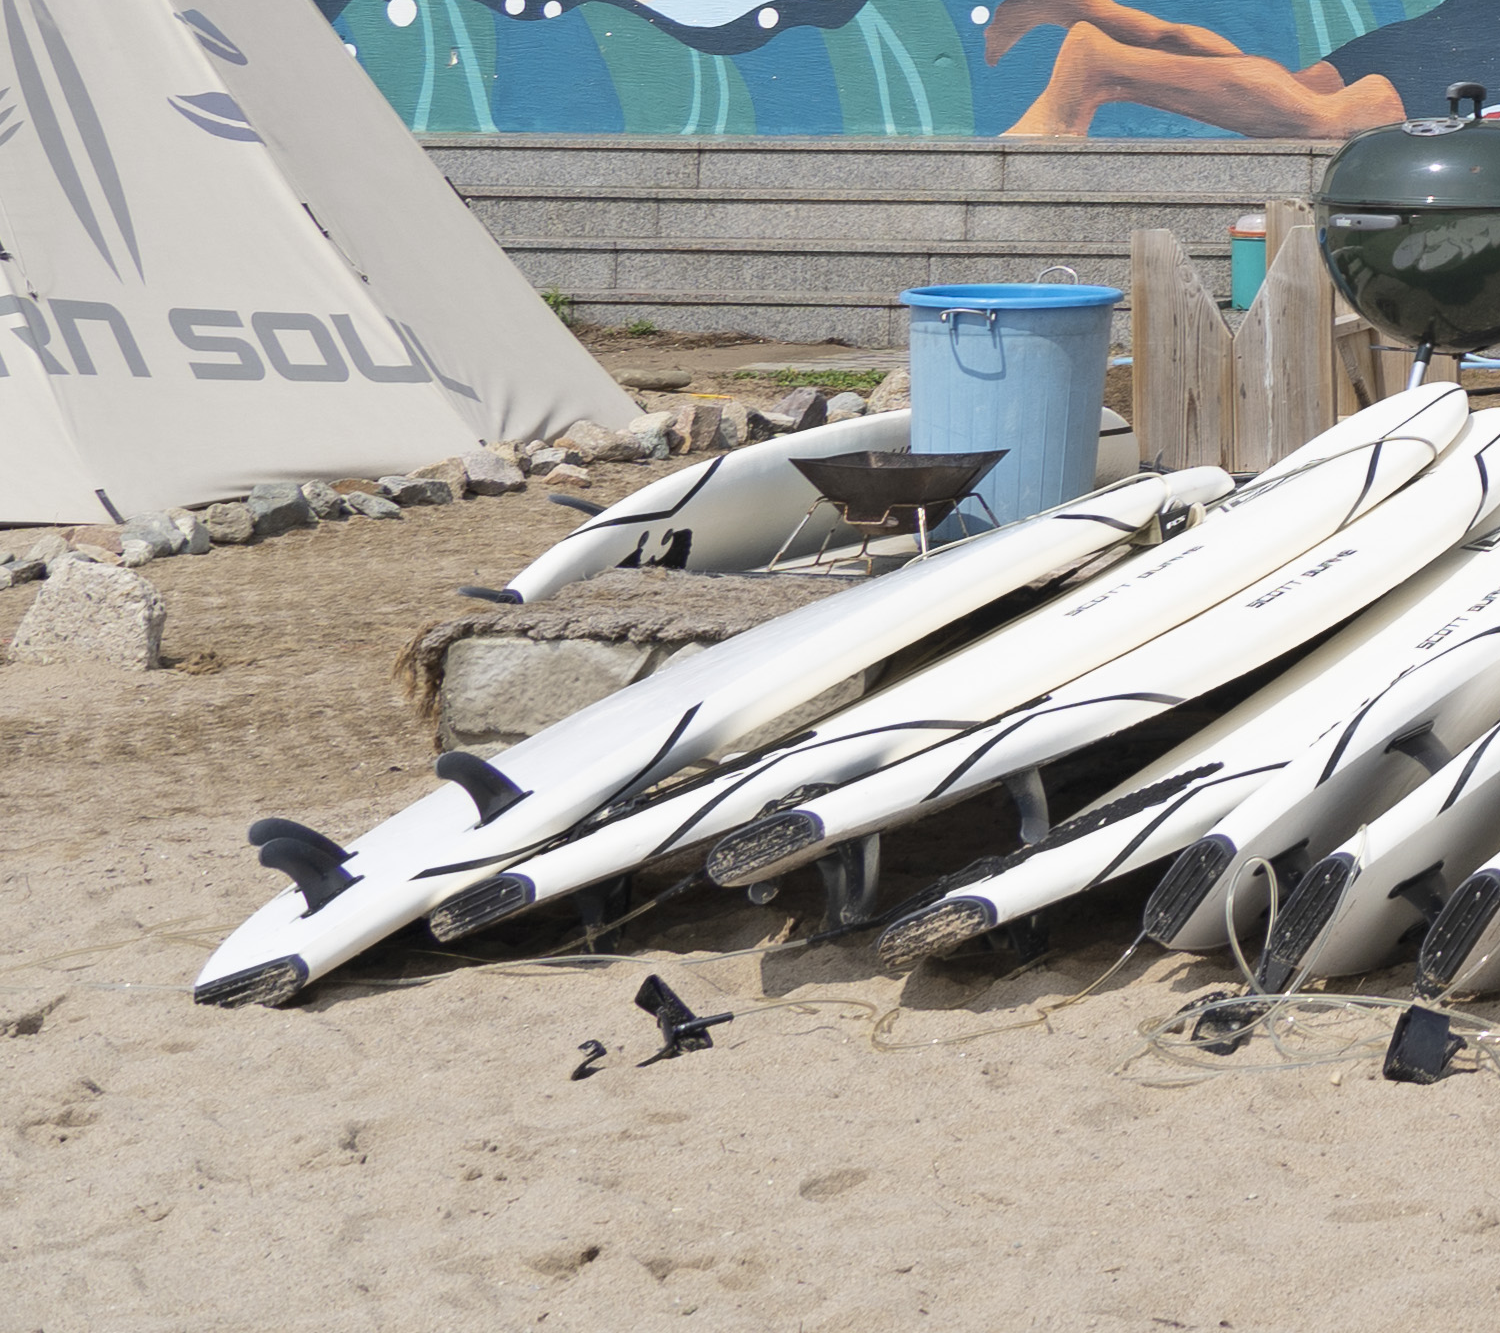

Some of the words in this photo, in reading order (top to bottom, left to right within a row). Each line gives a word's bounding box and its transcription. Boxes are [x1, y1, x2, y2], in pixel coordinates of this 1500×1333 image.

[169, 306, 482, 404] SOUL
[1064, 583, 1131, 618] SCOTT
[1245, 579, 1302, 609] SCOTT
[1415, 615, 1469, 650] SCOTT
